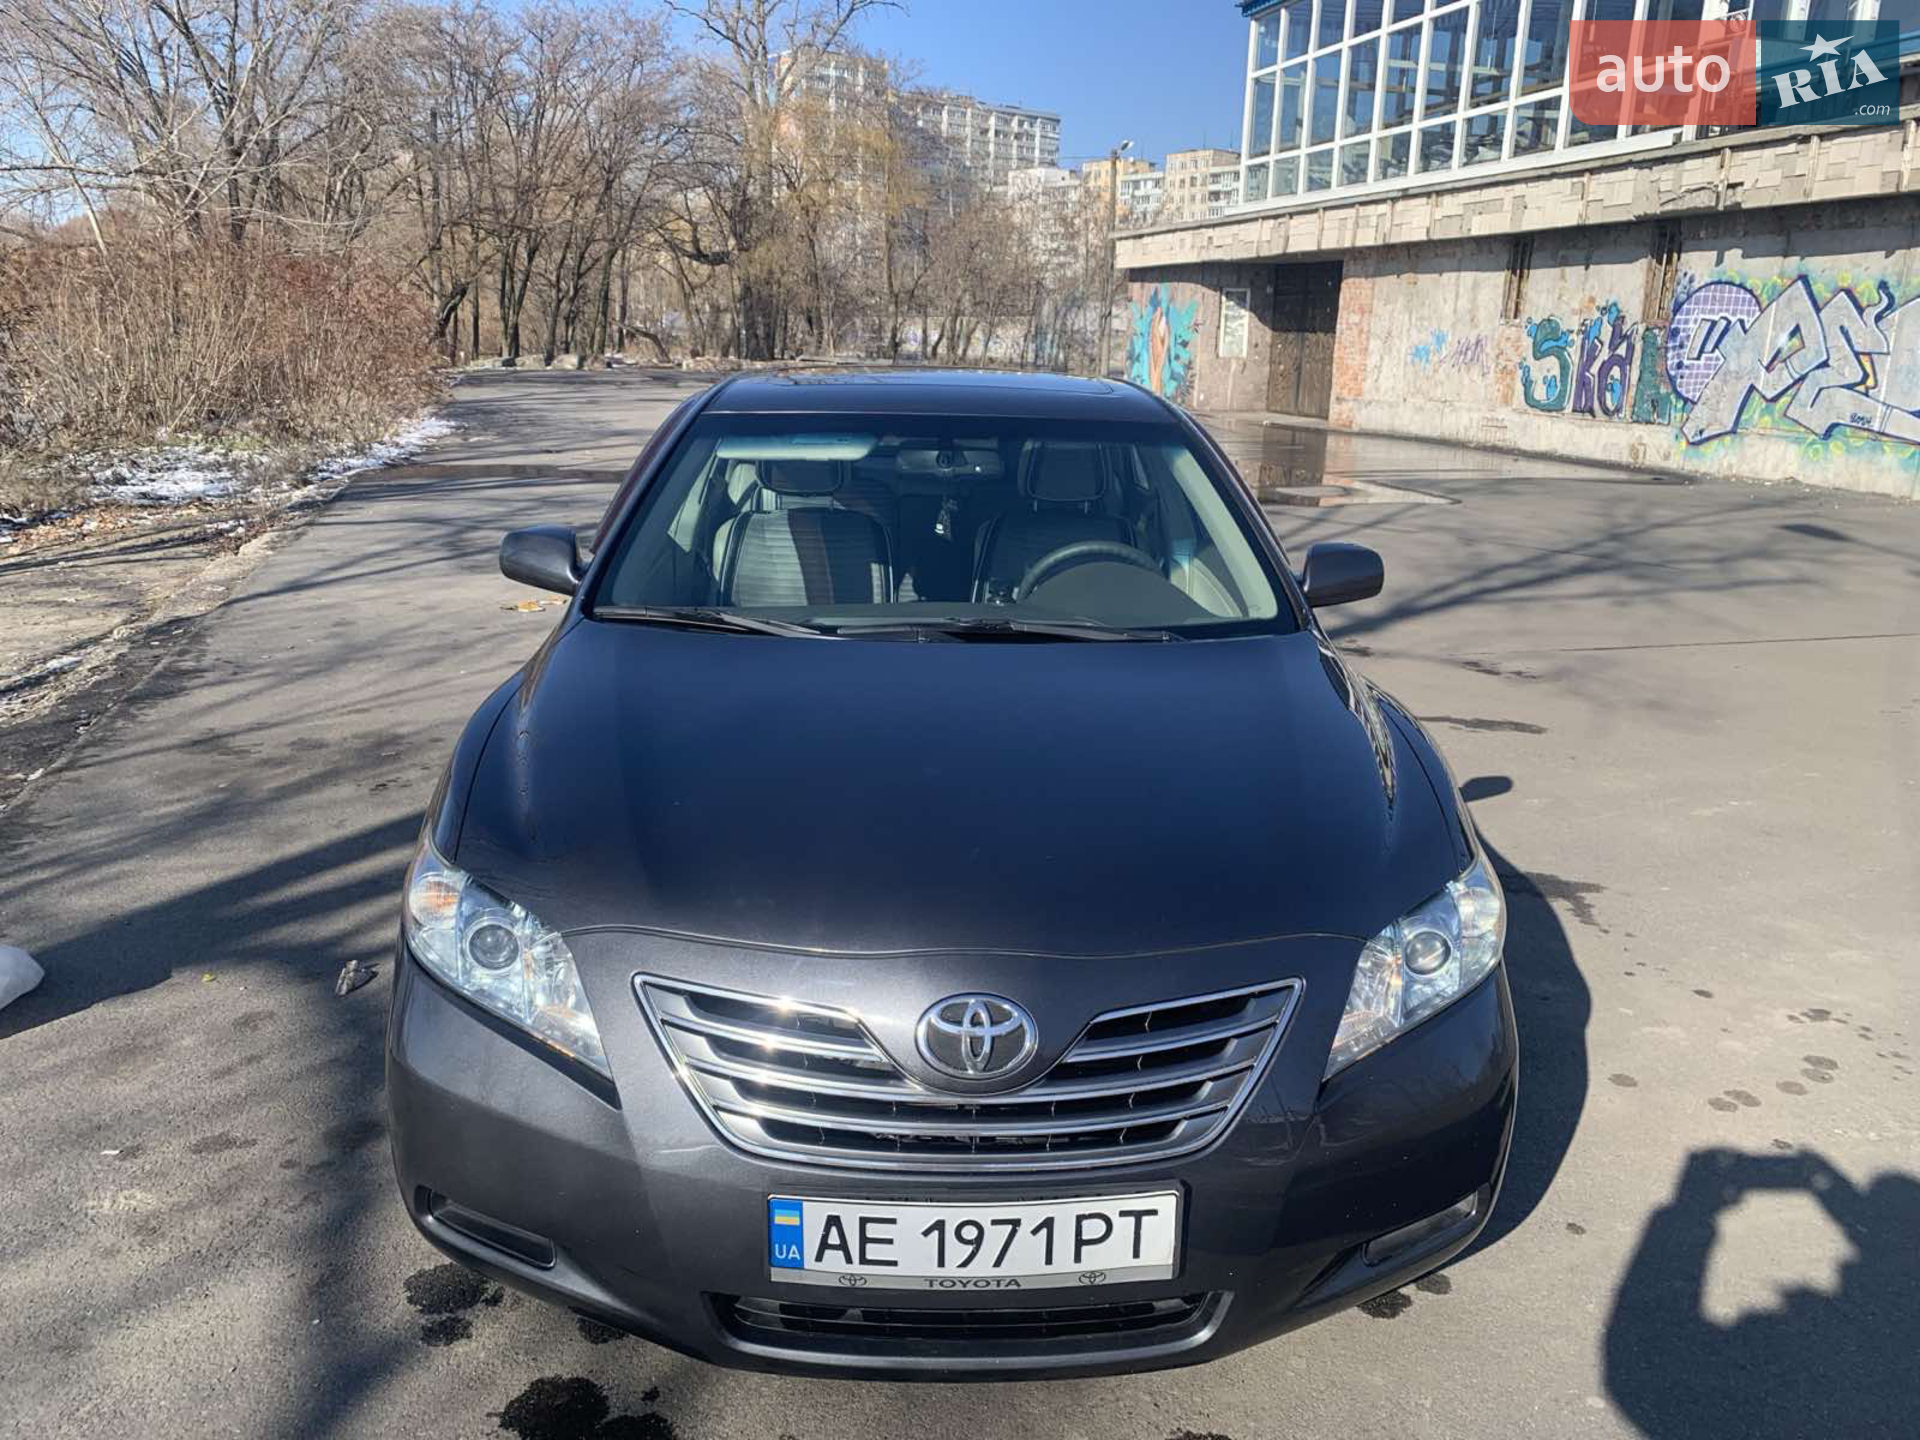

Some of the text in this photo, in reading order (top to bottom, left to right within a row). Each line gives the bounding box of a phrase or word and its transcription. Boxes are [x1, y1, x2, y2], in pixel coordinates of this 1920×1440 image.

[814, 1208, 1159, 1269] AE 1971 PT
[774, 1244, 801, 1260] UA
[923, 1278, 1021, 1290] TOYOTA
